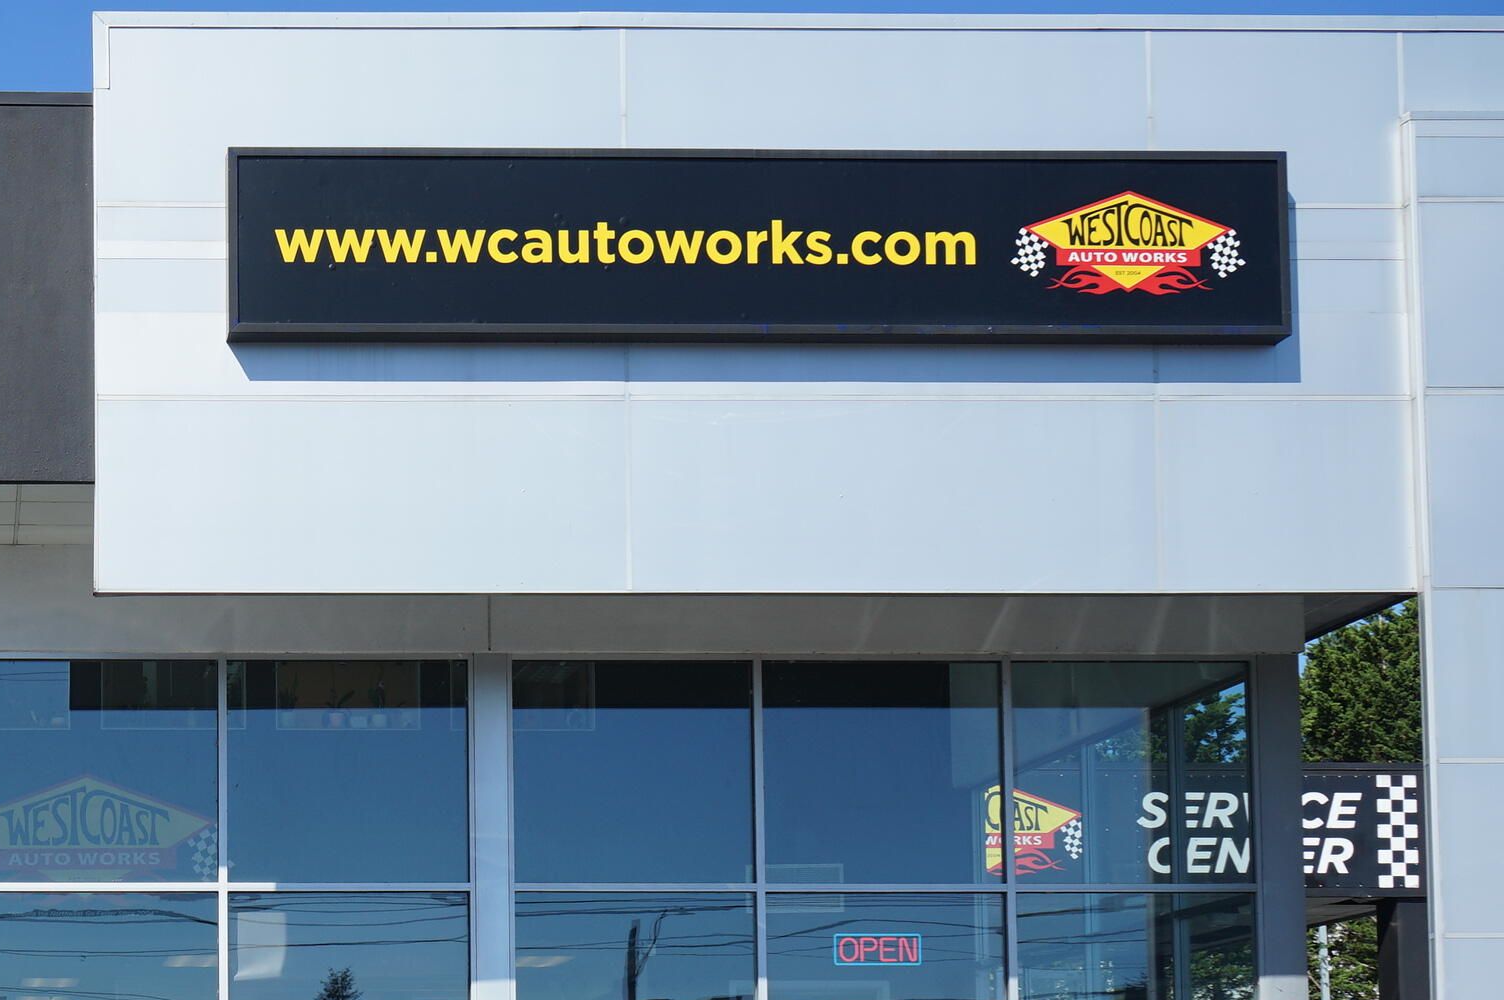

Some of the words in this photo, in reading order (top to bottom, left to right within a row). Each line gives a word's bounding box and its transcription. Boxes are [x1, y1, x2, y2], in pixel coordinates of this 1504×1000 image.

[275, 220, 977, 266] www.wcautoworks.com
[1068, 252, 1117, 263] AUTO
[1121, 252, 1188, 264] WORKS
[1136, 792, 1362, 829] SERCE
[8, 853, 71, 866] AUTO
[78, 852, 161, 866] WORKS
[1148, 837, 1354, 874] CENER
[838, 937, 918, 962] OPEN
